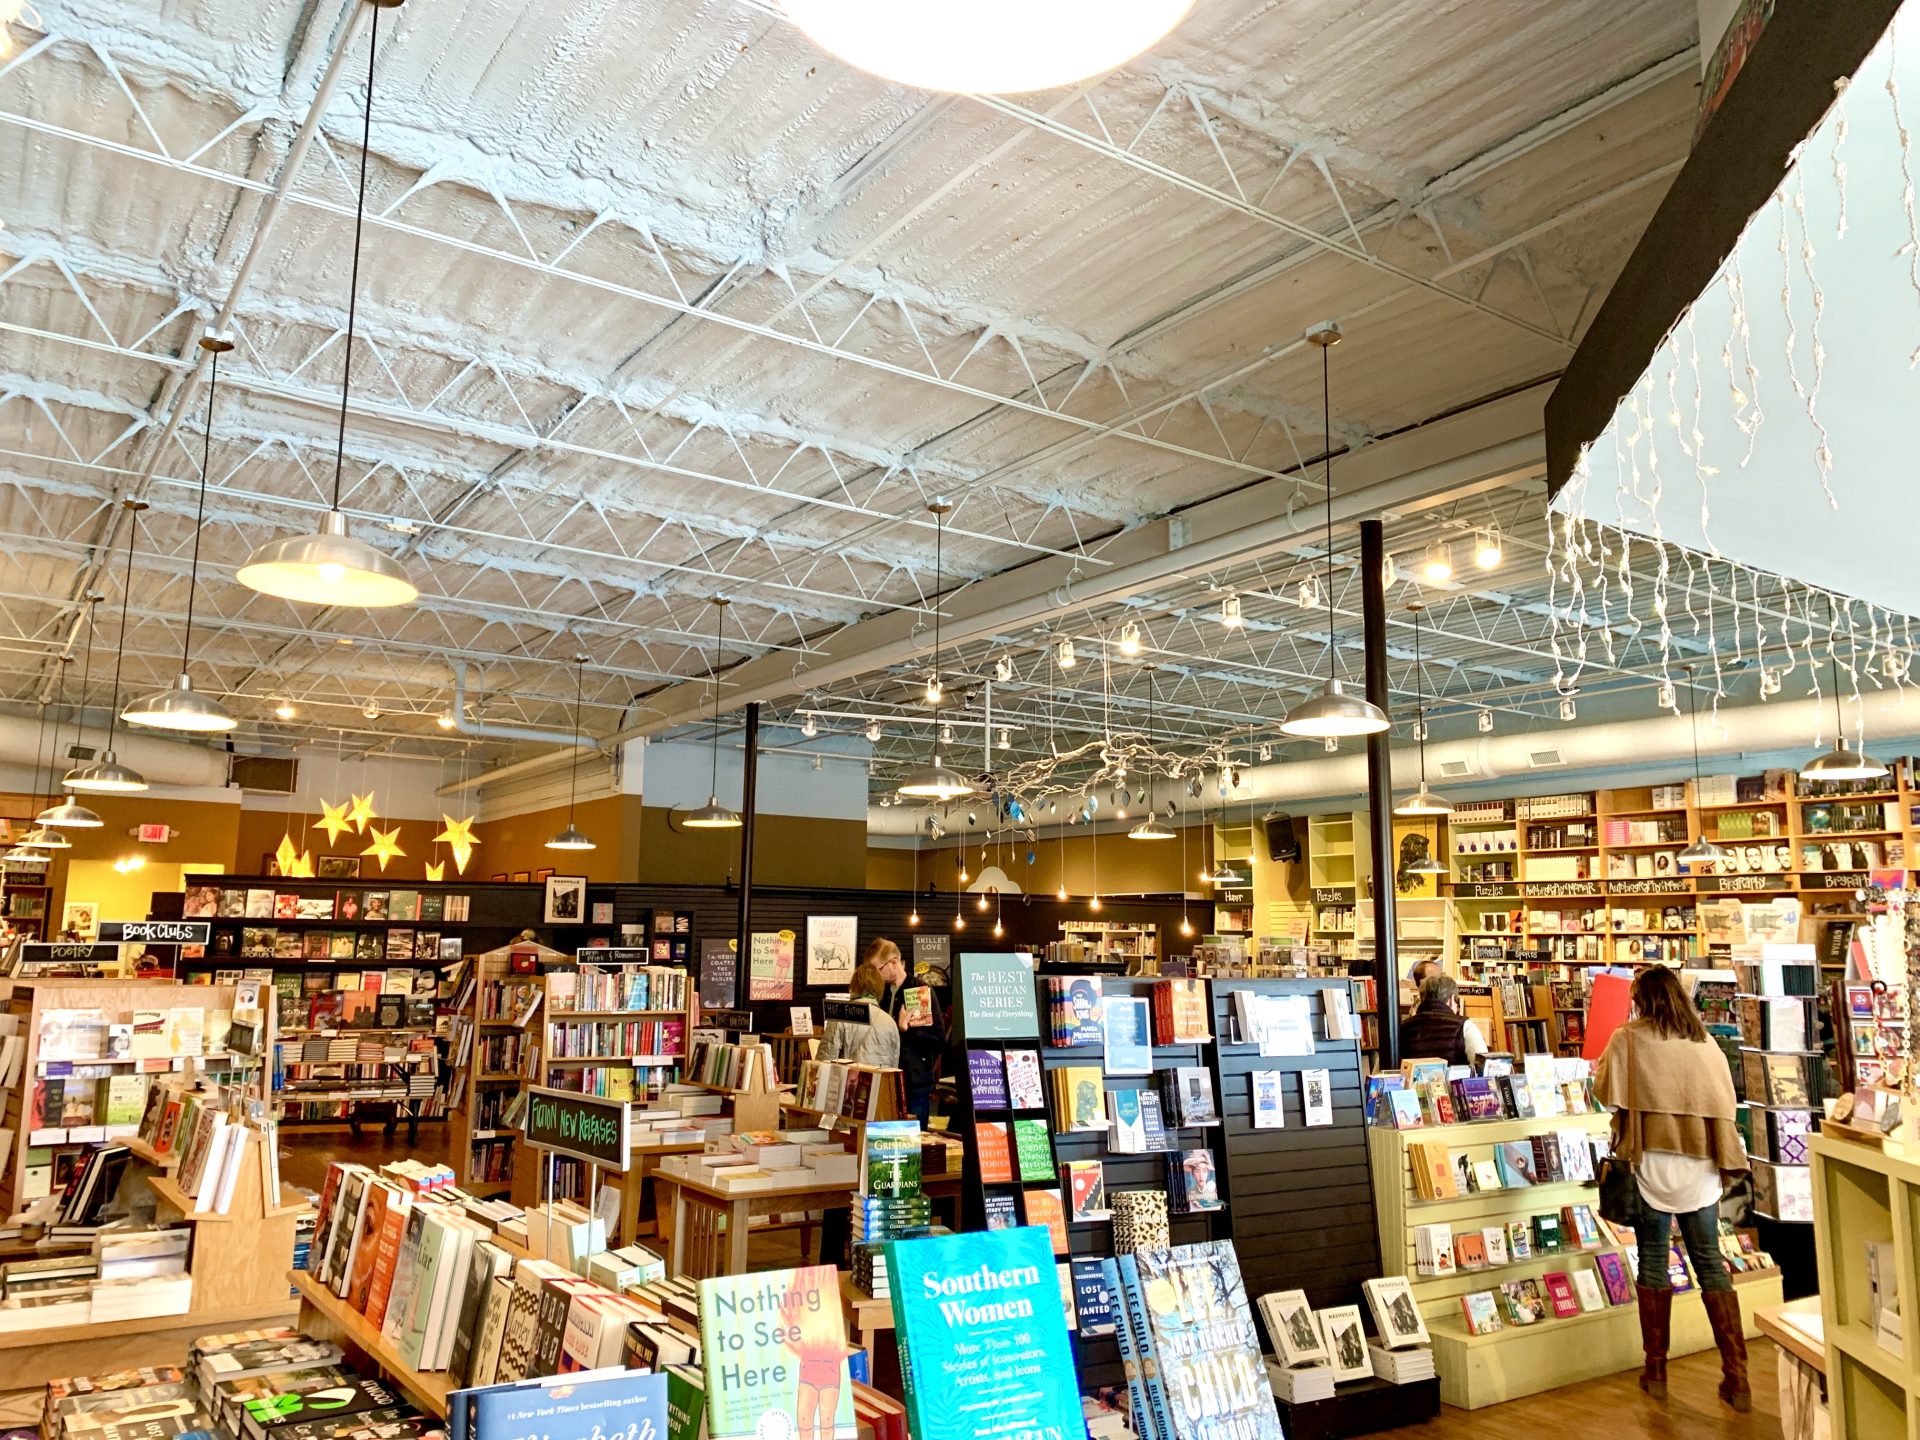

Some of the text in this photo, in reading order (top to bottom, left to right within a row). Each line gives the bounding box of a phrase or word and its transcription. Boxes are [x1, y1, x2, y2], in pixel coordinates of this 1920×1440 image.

[123, 924, 156, 941] Book
[764, 947, 779, 955] See
[971, 971, 1026, 984] The BEST
[971, 985, 1027, 995] AMERICAN
[979, 997, 1023, 1008] SERIES
[1002, 1010, 1034, 1019] Everything
[971, 1077, 1004, 1086] Mystery
[560, 1108, 578, 1138] NEW
[579, 1110, 617, 1146] RELEASES
[874, 1139, 915, 1151] GRISHAM
[873, 1180, 918, 1190] GUARDIANS
[417, 1242, 433, 1272] Liar
[922, 1264, 1041, 1299] Southern
[1081, 1285, 1101, 1294] LOST
[715, 1284, 821, 1318] Nothing
[1274, 1295, 1301, 1303] NASHVILLE
[939, 1298, 1034, 1329] Women
[1108, 1288, 1130, 1355] LEE CHILD
[1126, 1284, 1149, 1353] LEE CHILD
[1328, 1311, 1355, 1319] NASHVILLE
[717, 1321, 802, 1352] to See
[954, 1342, 981, 1356] More
[1014, 1333, 1031, 1346] 100
[942, 1359, 978, 1374] Stories
[980, 1356, 990, 1368] of
[995, 1367, 1012, 1381] and
[1014, 1363, 1041, 1377] Icons
[721, 1363, 787, 1391] Here
[1178, 1352, 1259, 1420] CHILD
[358, 1379, 394, 1405] ATWOOD
[1130, 1386, 1142, 1409] BLUE
[1150, 1384, 1162, 1408] BLUE
[516, 1411, 535, 1419] New
[536, 1407, 555, 1416] York
[556, 1404, 580, 1415] Times
[581, 1399, 622, 1411] bestselling
[623, 1396, 647, 1406] author
[667, 1400, 691, 1426] RYTHING
